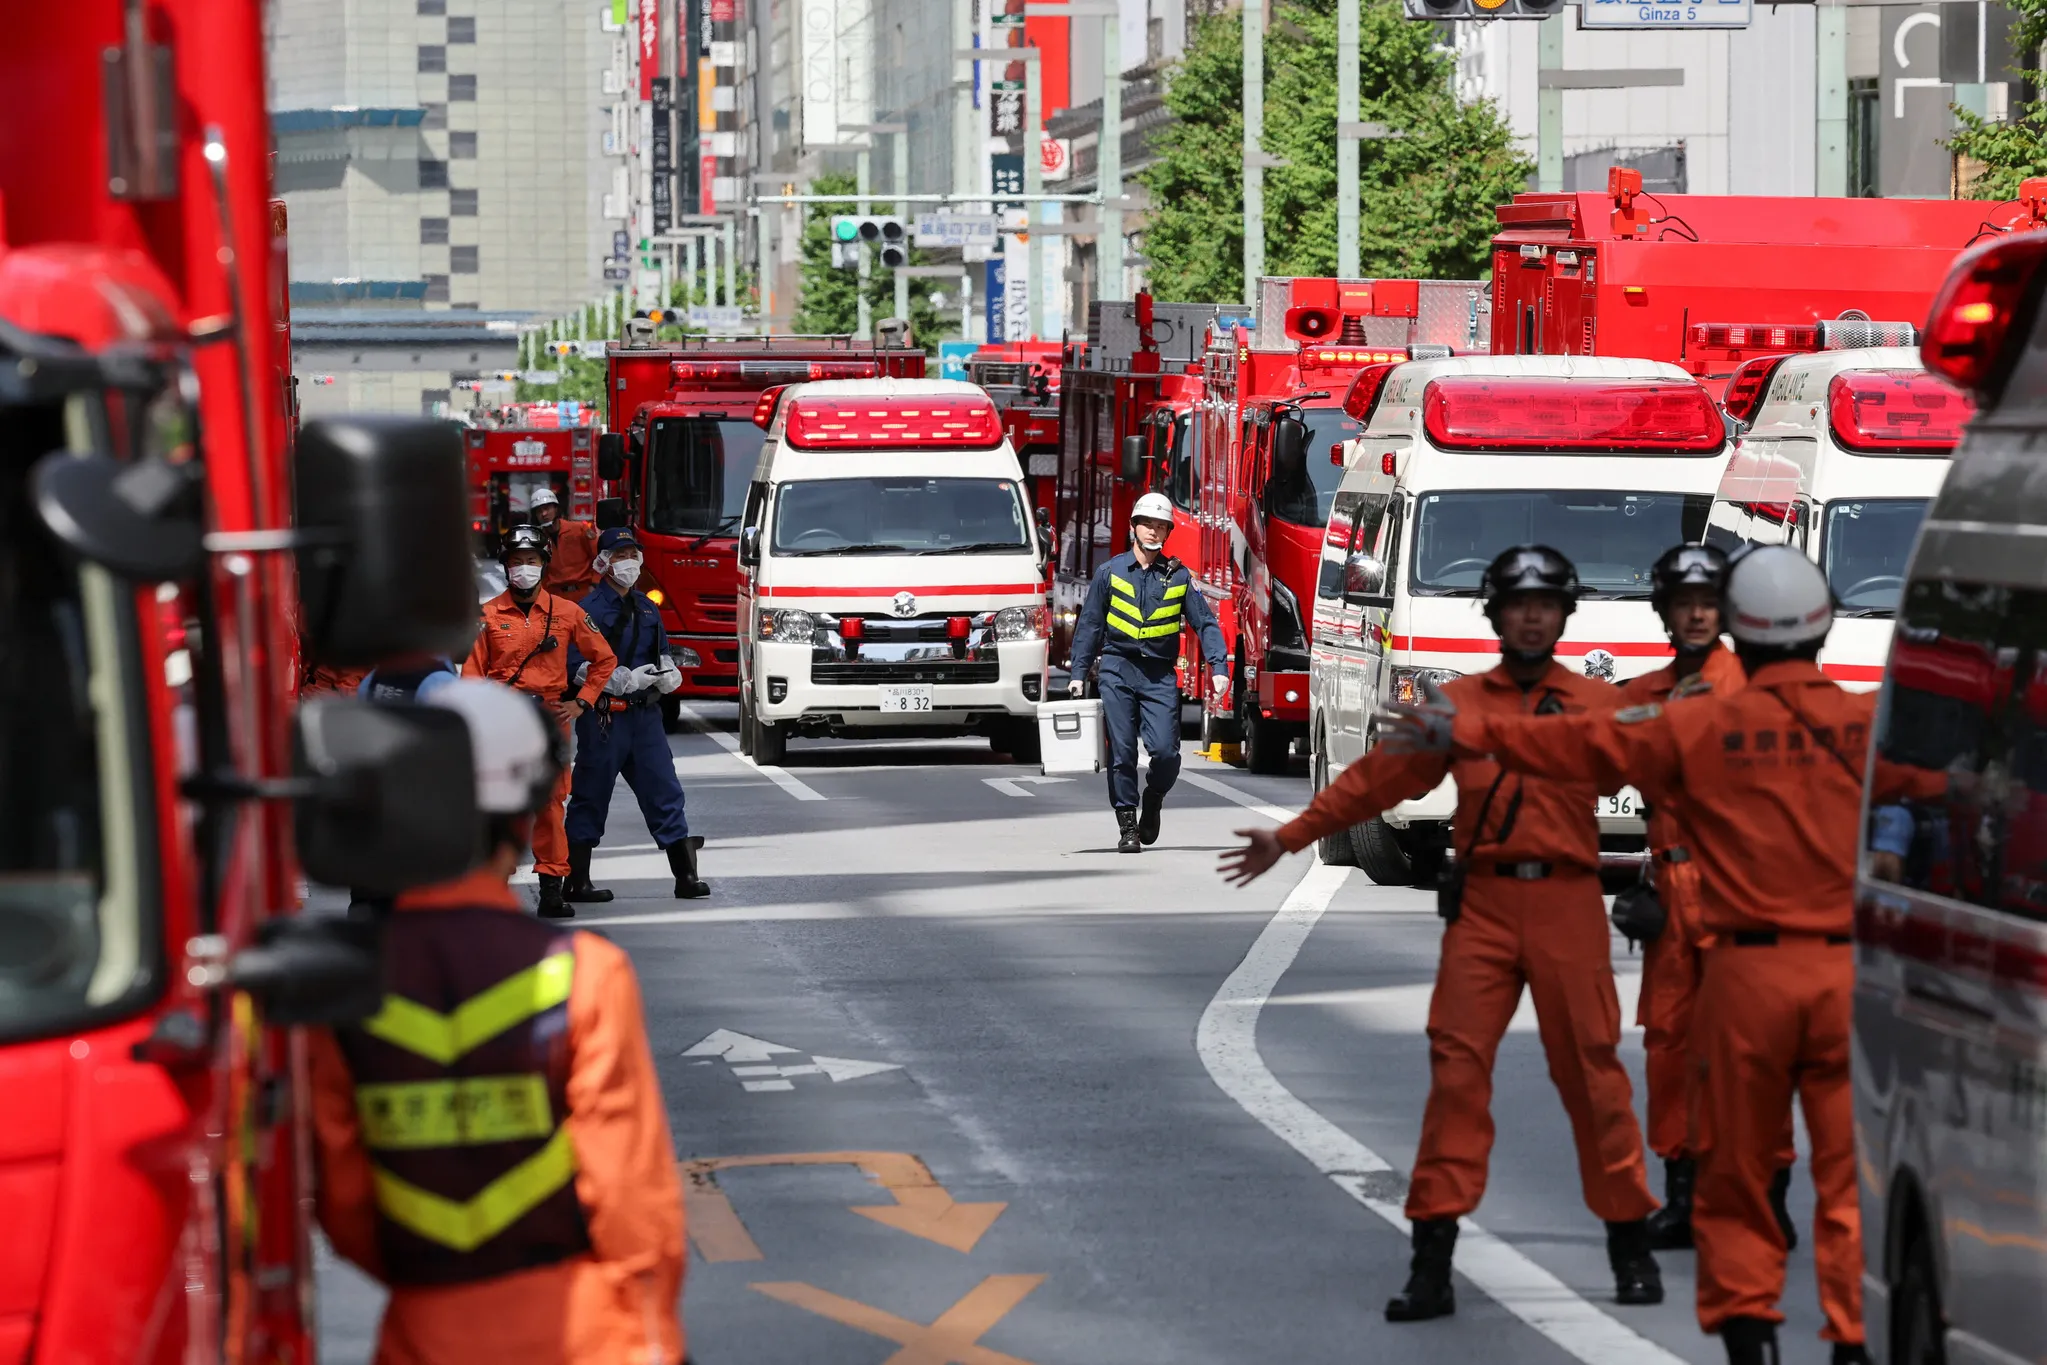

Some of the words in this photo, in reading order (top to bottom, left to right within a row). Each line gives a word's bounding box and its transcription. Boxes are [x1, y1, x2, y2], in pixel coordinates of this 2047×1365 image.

[1639, 6, 1680, 21] Ginza
[1687, 6, 1697, 21] 5
[673, 559, 720, 568] HINO
